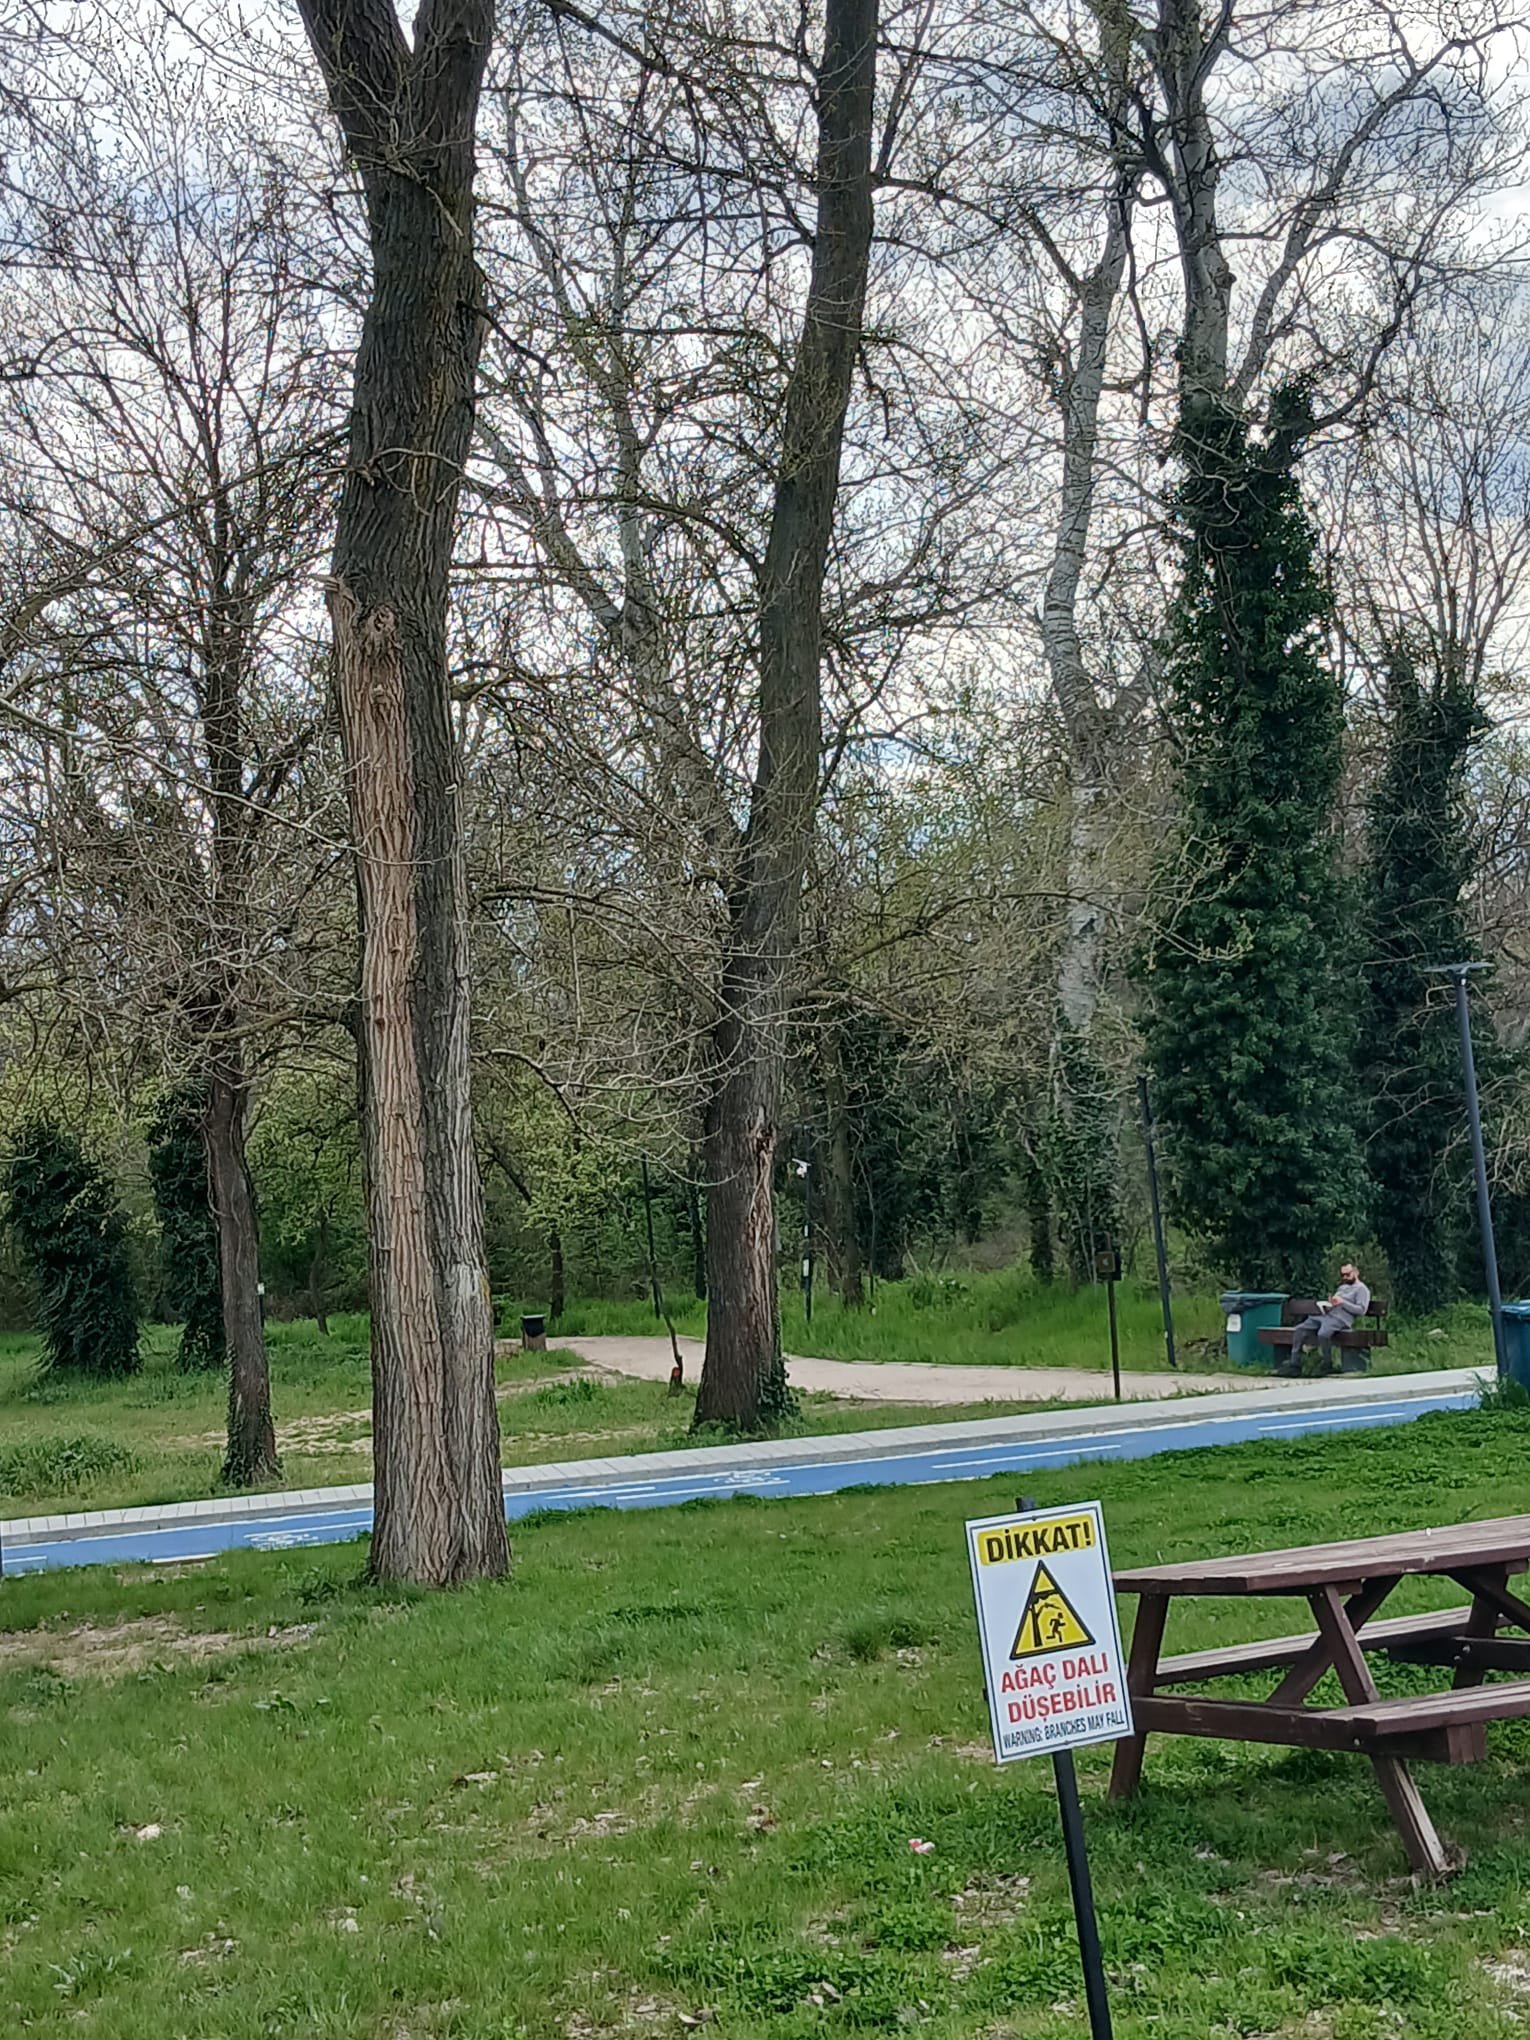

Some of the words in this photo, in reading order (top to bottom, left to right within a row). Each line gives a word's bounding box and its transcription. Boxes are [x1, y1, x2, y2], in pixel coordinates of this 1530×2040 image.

[986, 1521, 1091, 1563] DİKKAT!
[1001, 1663, 1056, 1693] AĞAÇ
[1062, 1652, 1109, 1681] DALI
[1008, 1682, 1117, 1723] DÜŞEBİLİR
[1003, 1727, 1043, 1749] WARNING:
[1045, 1717, 1086, 1740] BRANCHES
[1087, 1713, 1104, 1731] MAY
[1107, 1710, 1125, 1728] FALL
